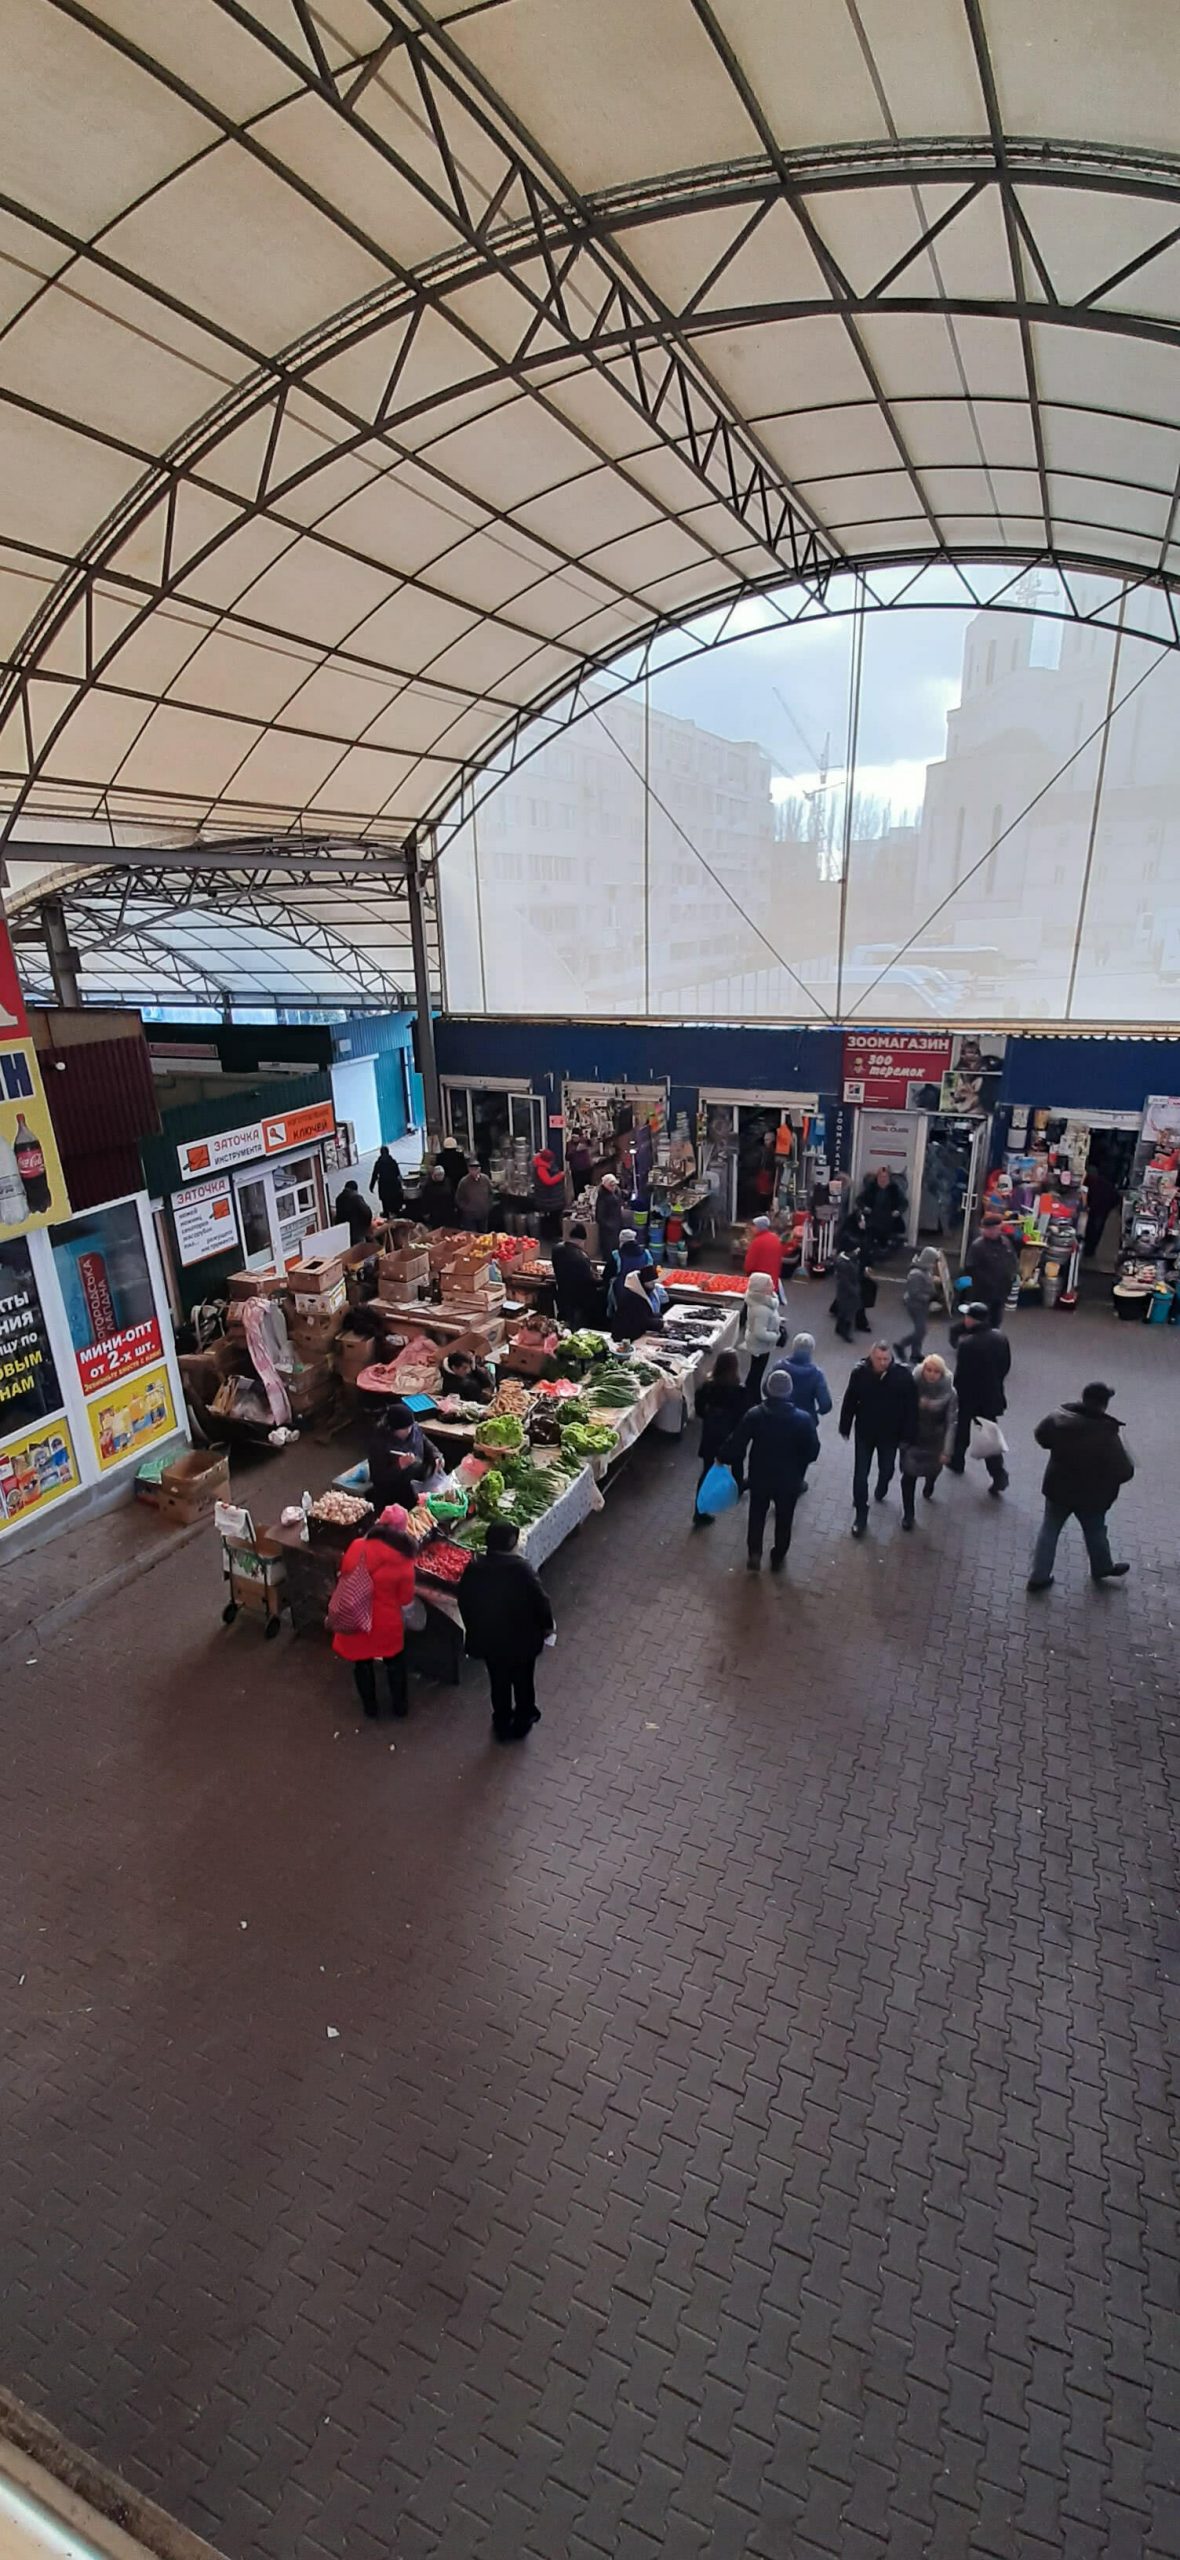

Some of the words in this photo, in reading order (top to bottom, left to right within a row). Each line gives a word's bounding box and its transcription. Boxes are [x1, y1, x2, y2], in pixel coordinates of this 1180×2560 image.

[847, 1035, 950, 1050] ЗООМАГАЗИН
[0, 1052, 34, 1101] Н
[868, 1066, 926, 1079] теремок
[213, 1129, 260, 1151] ЗАТОЧКА
[292, 1120, 328, 1141] КЛЮЧЕЙ
[214, 1144, 262, 1165] ИНСТРУМЕНТА
[177, 1179, 226, 1205] ЗАТОЧКА
[79, 1319, 153, 1365] МИНИ-ОПТ
[0, 1375, 35, 1401] НАМ
